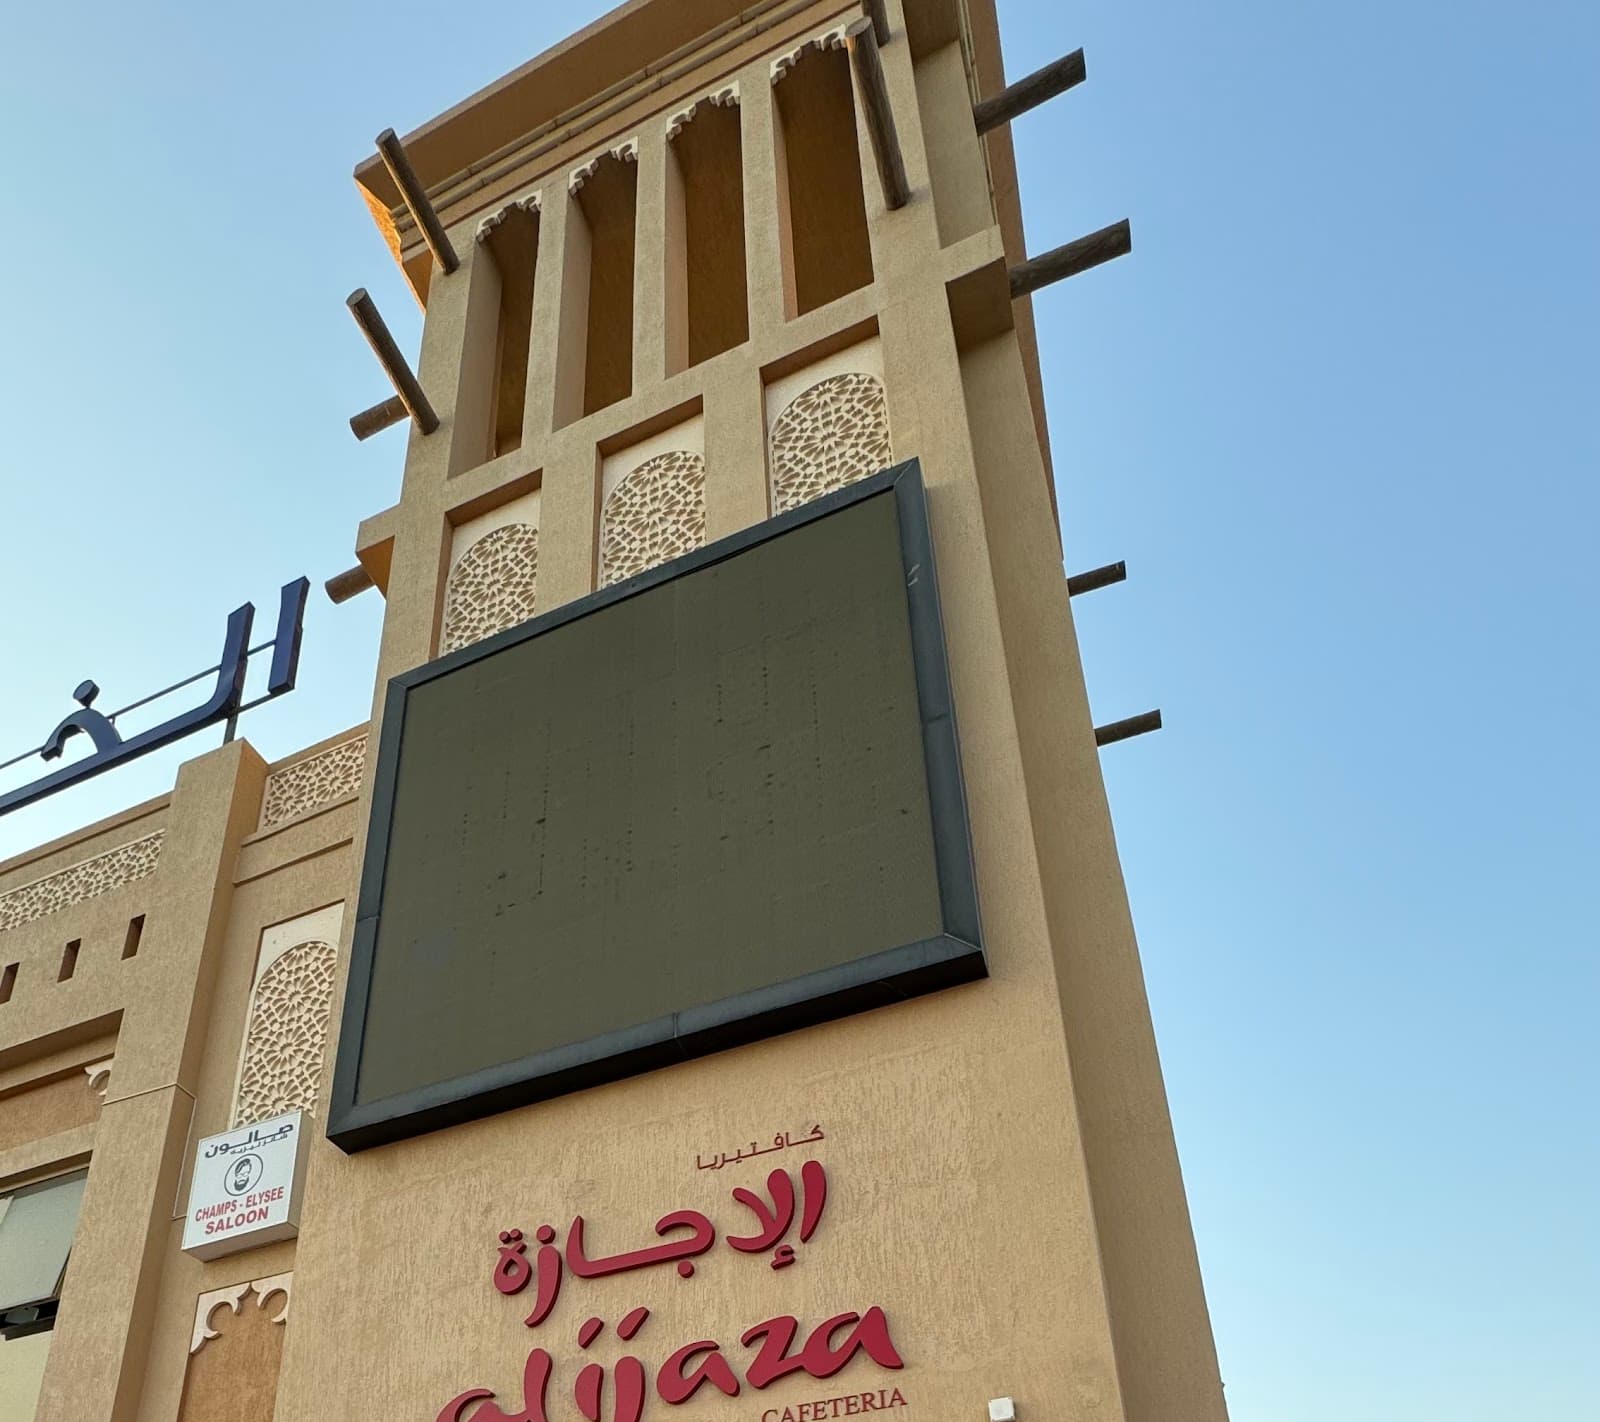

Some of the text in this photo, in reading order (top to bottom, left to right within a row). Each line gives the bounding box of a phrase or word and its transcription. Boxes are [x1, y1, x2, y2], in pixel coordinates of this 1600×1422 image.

[204, 1124, 294, 1158] صالون
[696, 1124, 825, 1170] كافتيريا
[195, 1199, 238, 1222] CHAMPS
[245, 1186, 285, 1208] ELYSEE
[204, 1206, 269, 1235] SALOON
[493, 1160, 828, 1328] الإجازة
